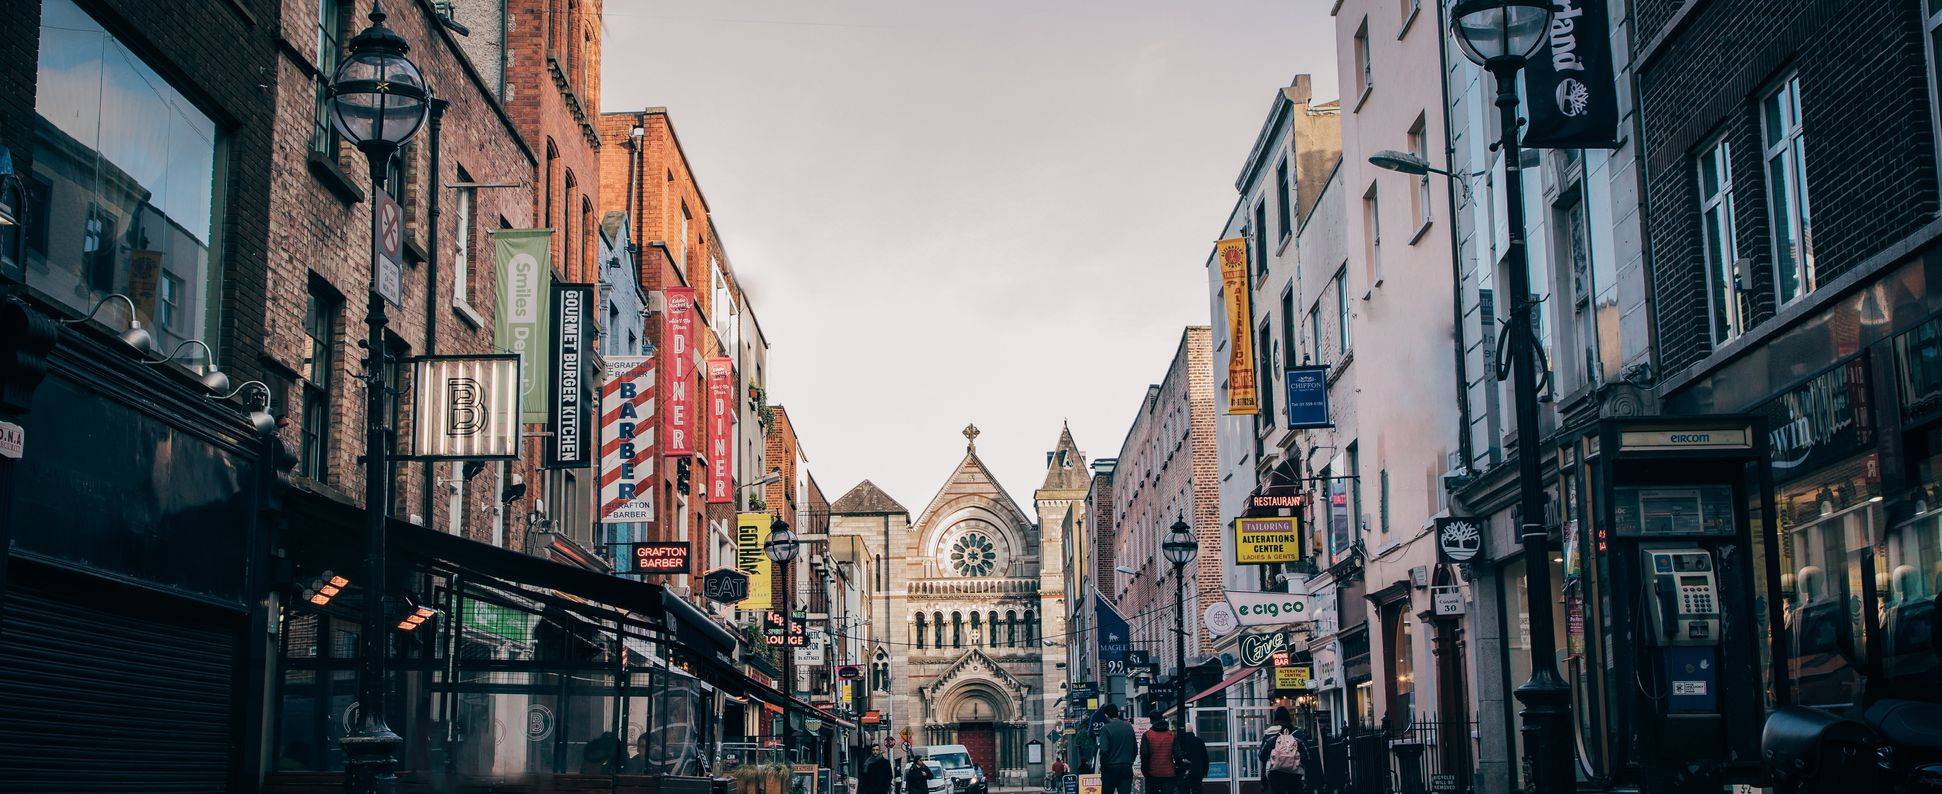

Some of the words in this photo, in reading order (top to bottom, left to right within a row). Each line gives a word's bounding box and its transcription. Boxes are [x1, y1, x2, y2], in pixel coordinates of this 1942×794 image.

[515, 262, 531, 318] Smiles
[563, 290, 579, 350] GOURMET
[613, 361, 650, 369] GRAFTON
[562, 353, 578, 402] BURGER
[614, 370, 648, 378] BARBER
[673, 334, 685, 449] DINER
[446, 378, 487, 436] B
[561, 405, 576, 461] KITCHEN
[1671, 434, 1710, 443] eircom
[618, 382, 638, 500] BARBER
[715, 399, 726, 497] DINER
[612, 501, 650, 509] GRAFTON
[1254, 496, 1300, 507] RESTAURANT
[1246, 522, 1289, 531] TAILORING
[1242, 535, 1295, 543] ALTERATIONS
[637, 547, 687, 557] GRAFTON
[640, 558, 683, 568] BARBER
[706, 576, 746, 598] EAT
[1239, 605, 1249, 616] e
[1253, 602, 1279, 617] cig
[1282, 601, 1304, 613] co
[1444, 604, 1457, 612] 30
[1108, 660, 1125, 674] 22
